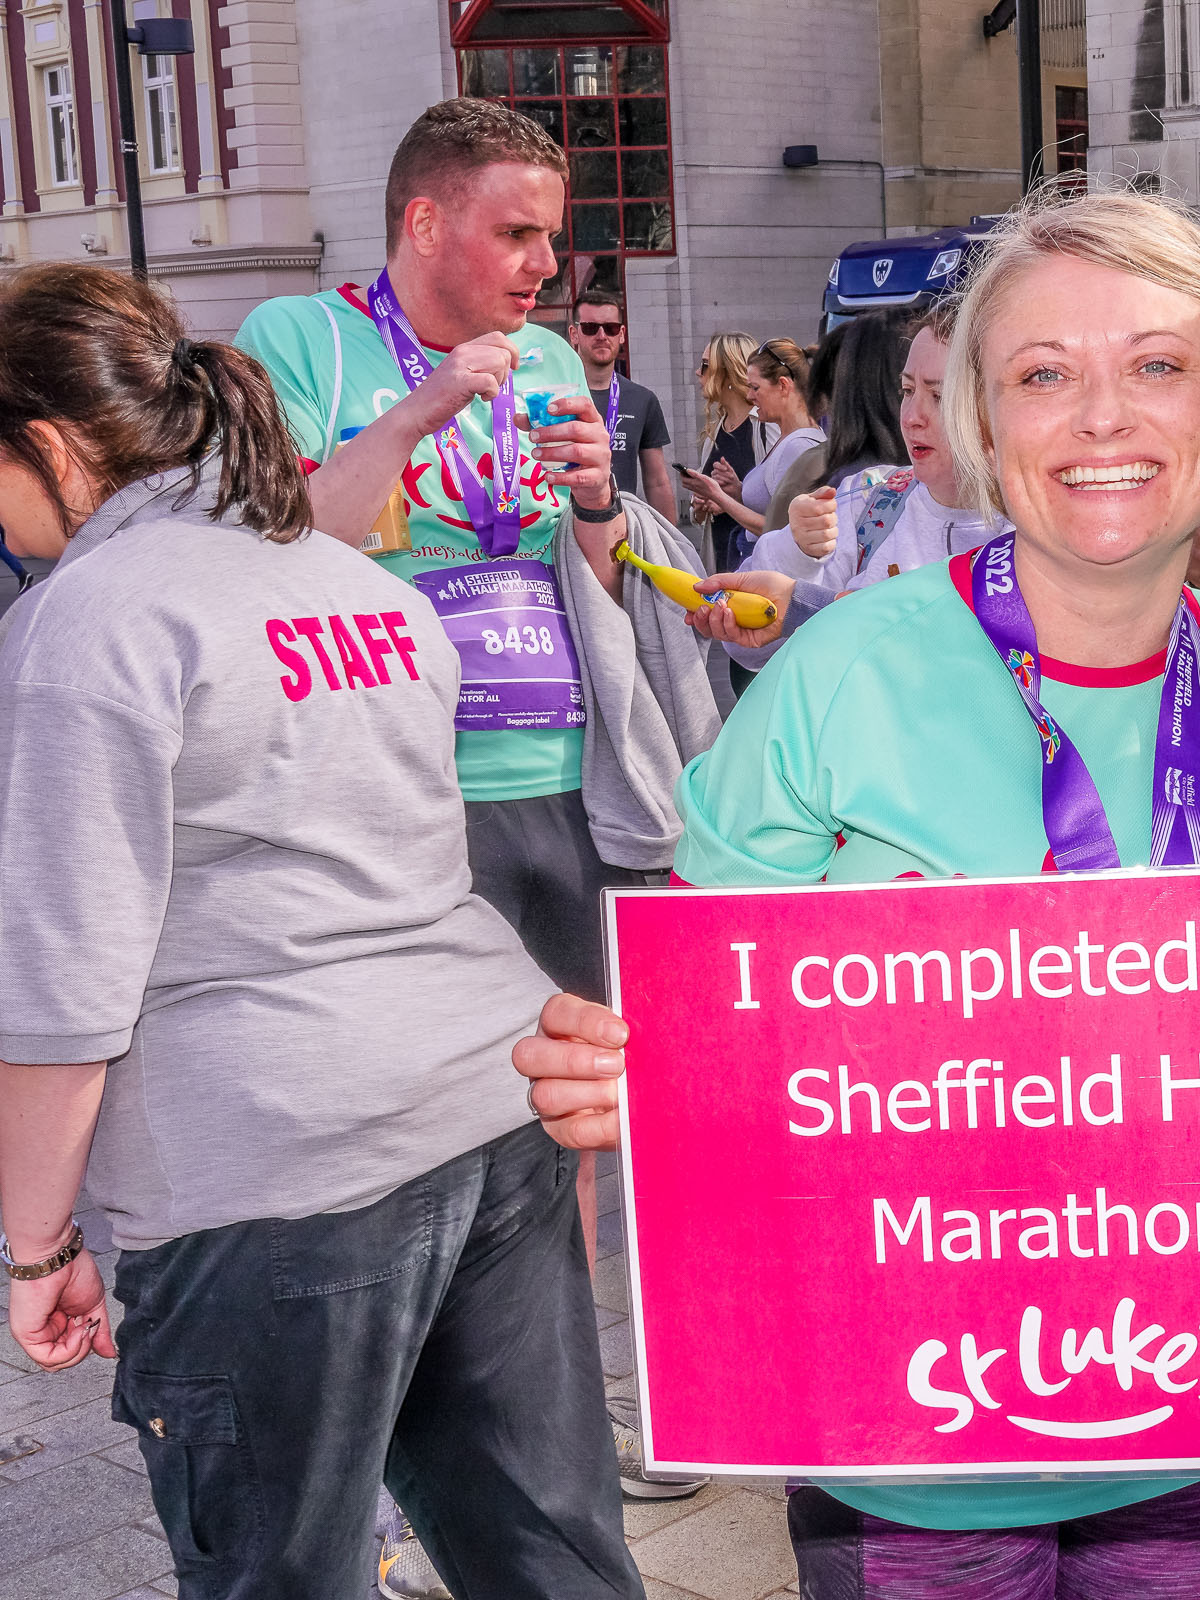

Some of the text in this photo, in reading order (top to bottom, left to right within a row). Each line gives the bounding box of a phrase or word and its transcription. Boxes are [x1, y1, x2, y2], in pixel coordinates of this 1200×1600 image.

[467, 571, 520, 585] SHEFFIELD
[985, 539, 1014, 597] 2022
[471, 579, 554, 596] HALF MARATHON
[536, 593, 556, 606] 2022
[266, 611, 420, 702] STAFF
[481, 625, 555, 655] 8438
[1184, 653, 1194, 707] SHEFFIELD
[468, 695, 485, 703] FOR
[486, 694, 501, 702] ALL
[1171, 648, 1187, 747] HALF MARATHON
[535, 716, 551, 724] label
[566, 712, 586, 722] 8438
[1186, 774, 1196, 807] Sheffield
[730, 943, 760, 1010] I
[791, 921, 1199, 1018] completed
[787, 1054, 1124, 1136] Sheffield
[906, 1332, 1008, 1434] St
